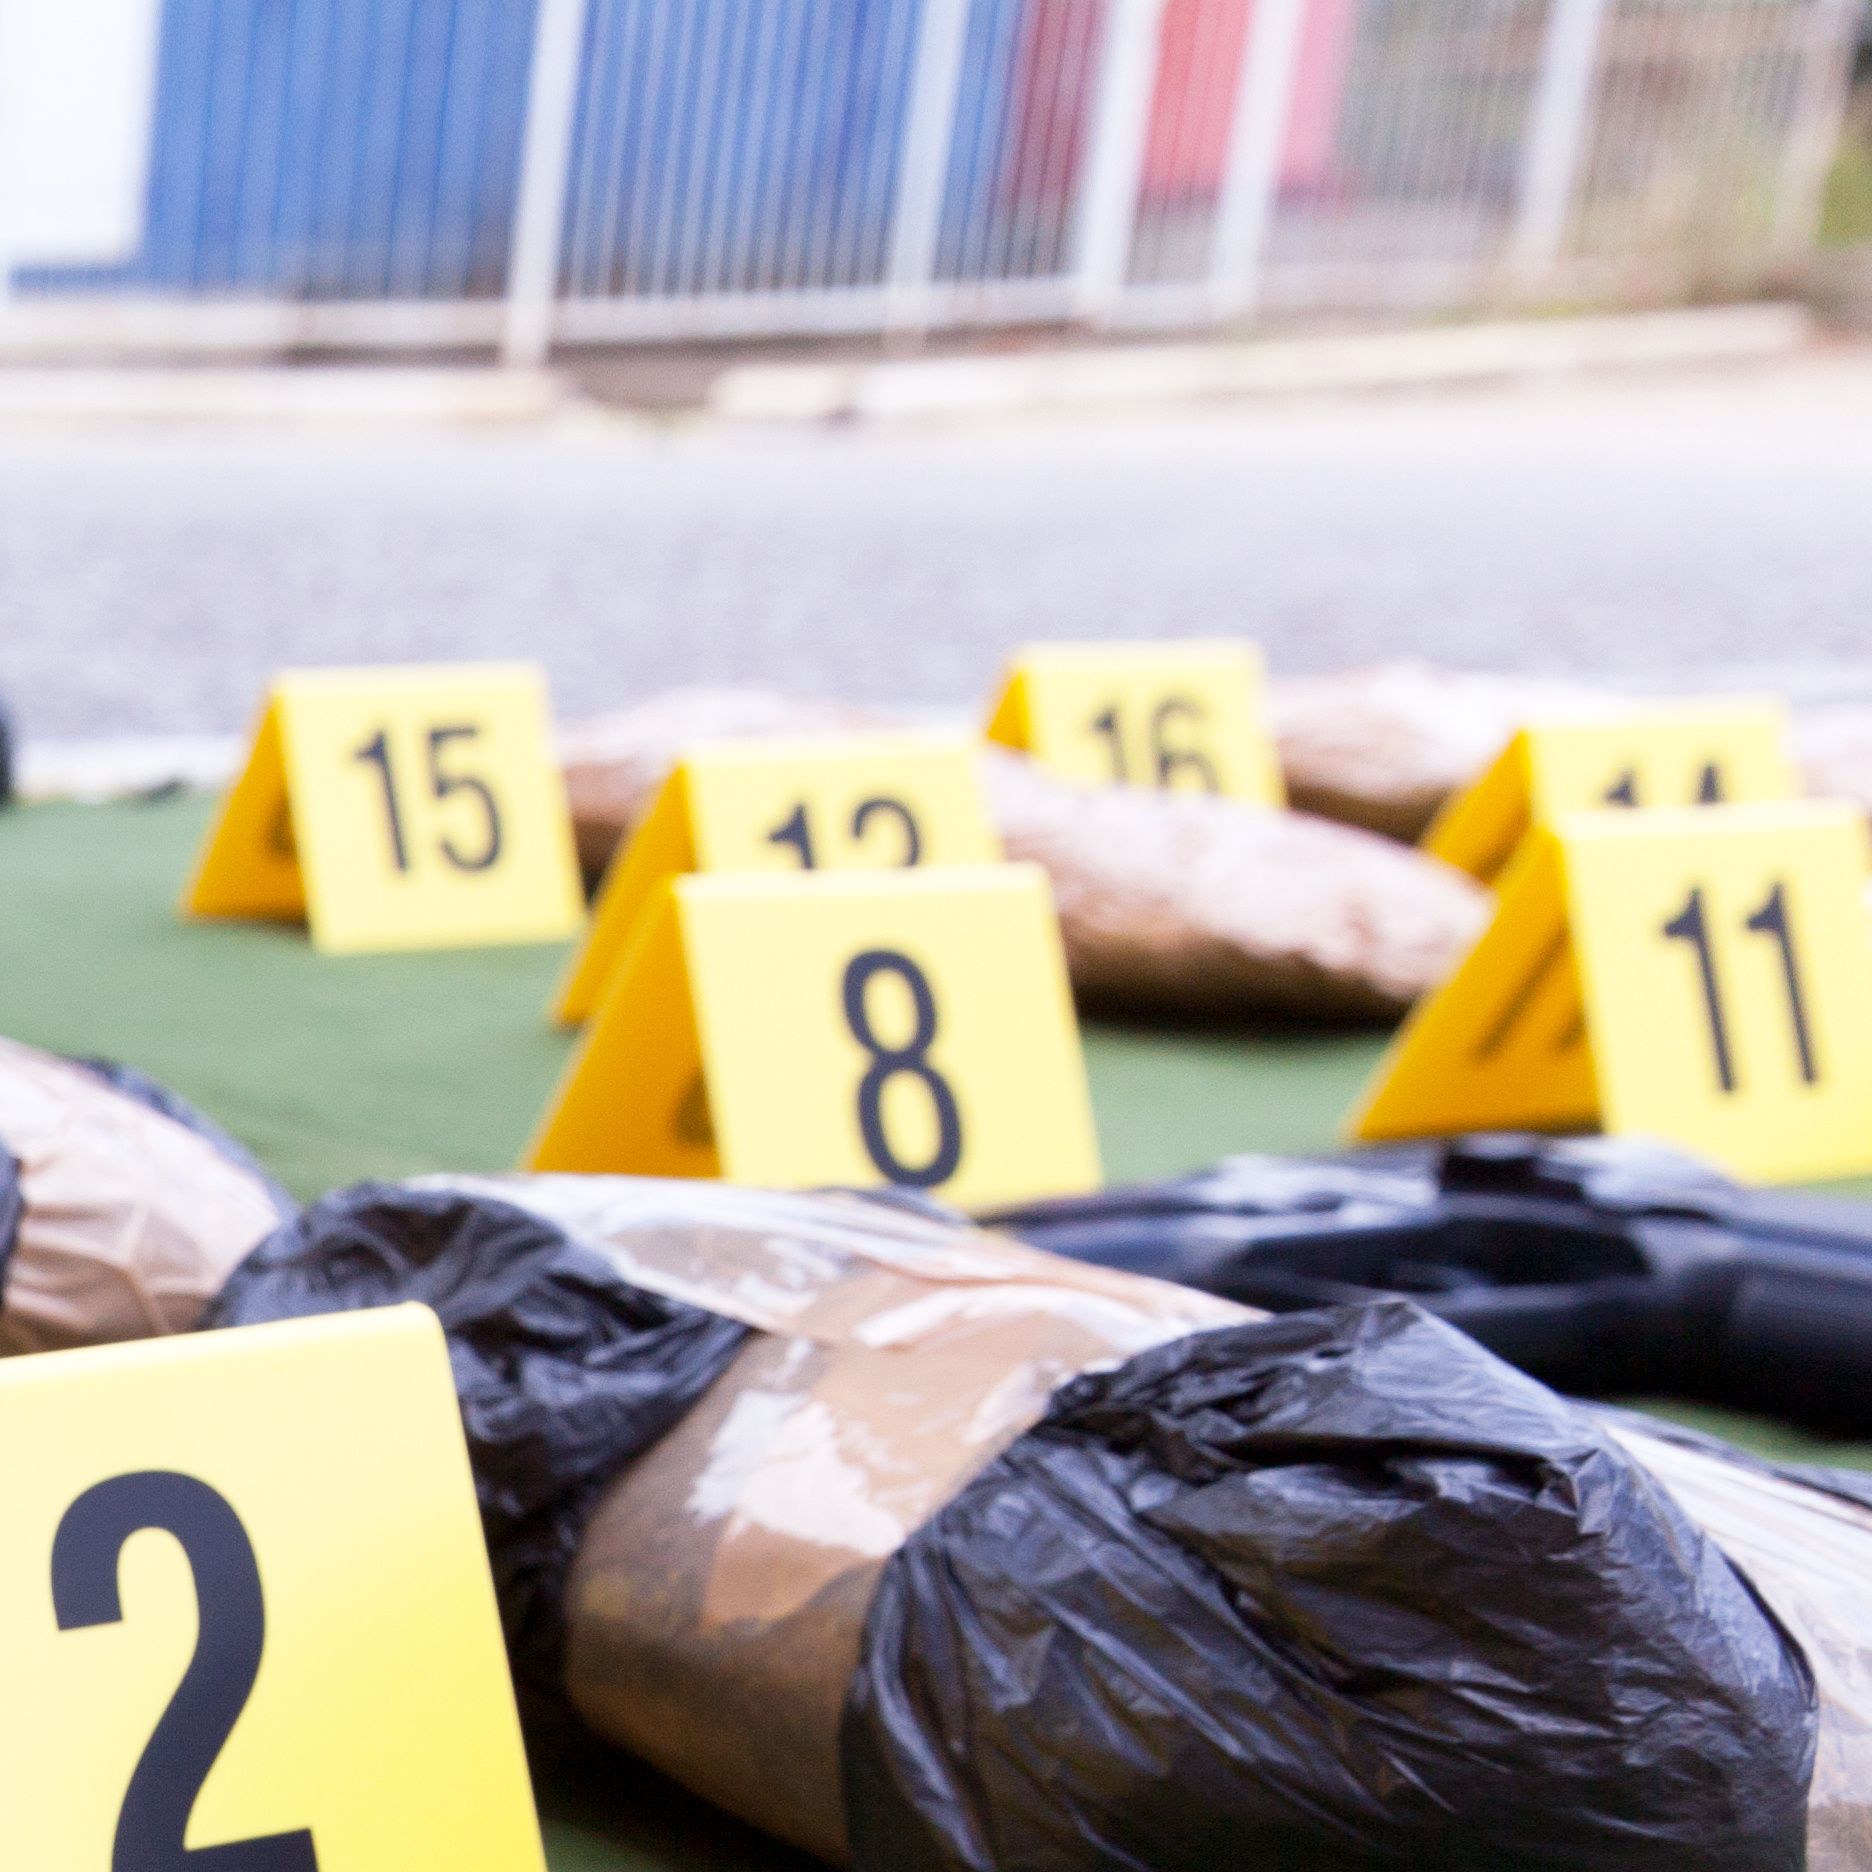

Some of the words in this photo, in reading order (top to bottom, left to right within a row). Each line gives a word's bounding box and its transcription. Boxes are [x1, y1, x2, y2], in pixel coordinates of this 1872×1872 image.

[354, 724, 505, 875] 15
[841, 948, 964, 1189] 8
[1662, 882, 1818, 1093] 11
